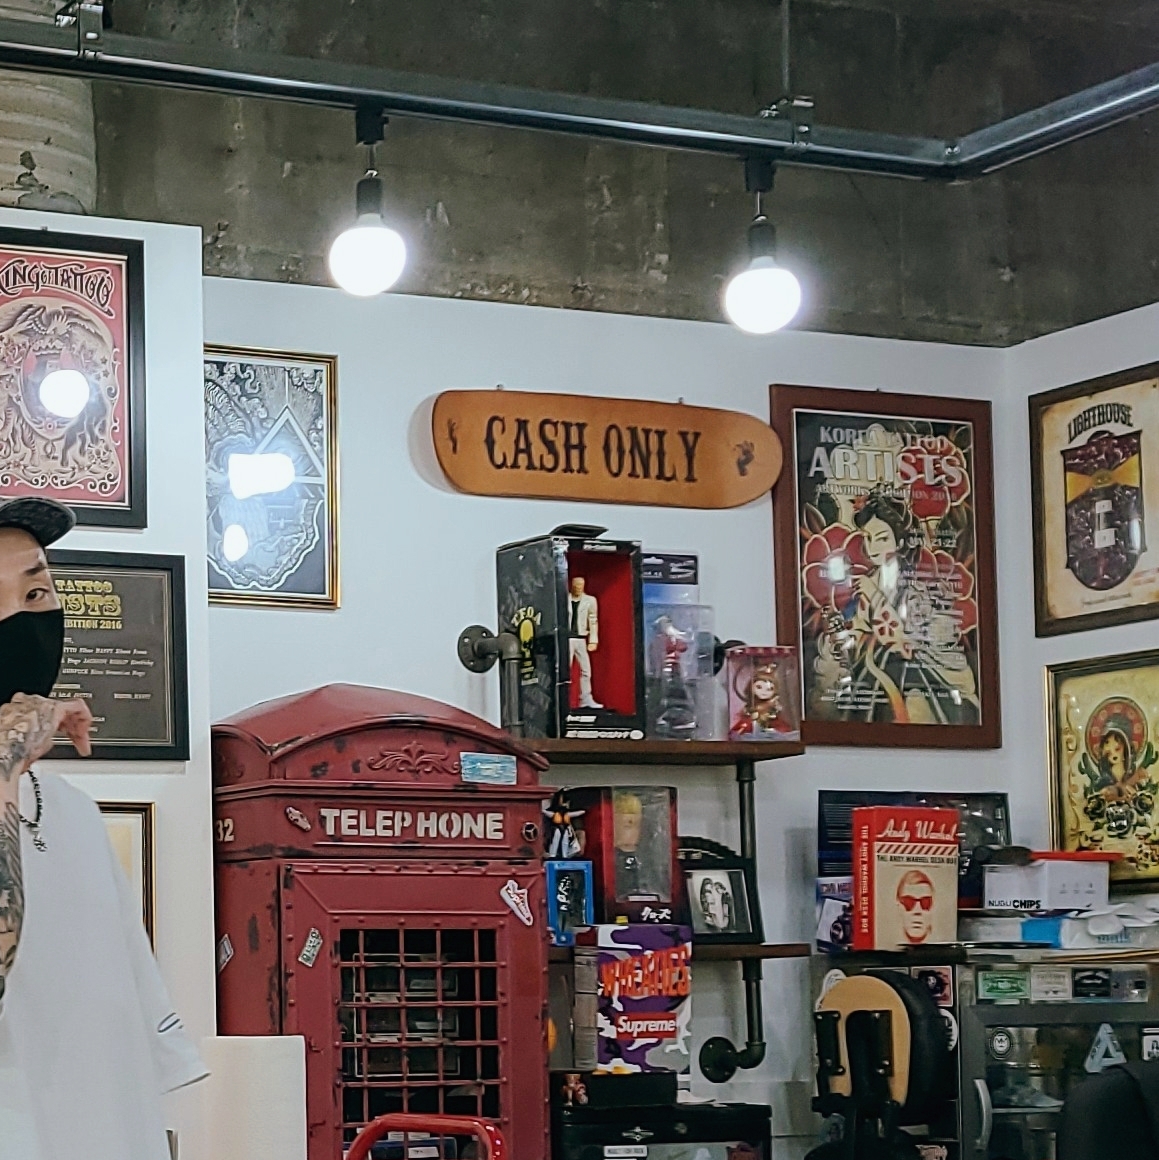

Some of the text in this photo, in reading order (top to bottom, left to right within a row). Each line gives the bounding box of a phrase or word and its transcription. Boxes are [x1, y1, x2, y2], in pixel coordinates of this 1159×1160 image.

[1067, 402, 1133, 443] LIGHTHOUSE
[484, 416, 702, 483] CASH ONLY
[808, 447, 962, 487] ARTISTS
[55, 580, 112, 592] TATTOO
[100, 620, 122, 629] 2016
[319, 808, 504, 840] TELEPHONE
[876, 818, 957, 842] Andy Warhol
[1013, 900, 1041, 909] CHIPS
[617, 1015, 676, 1037] Supreme
